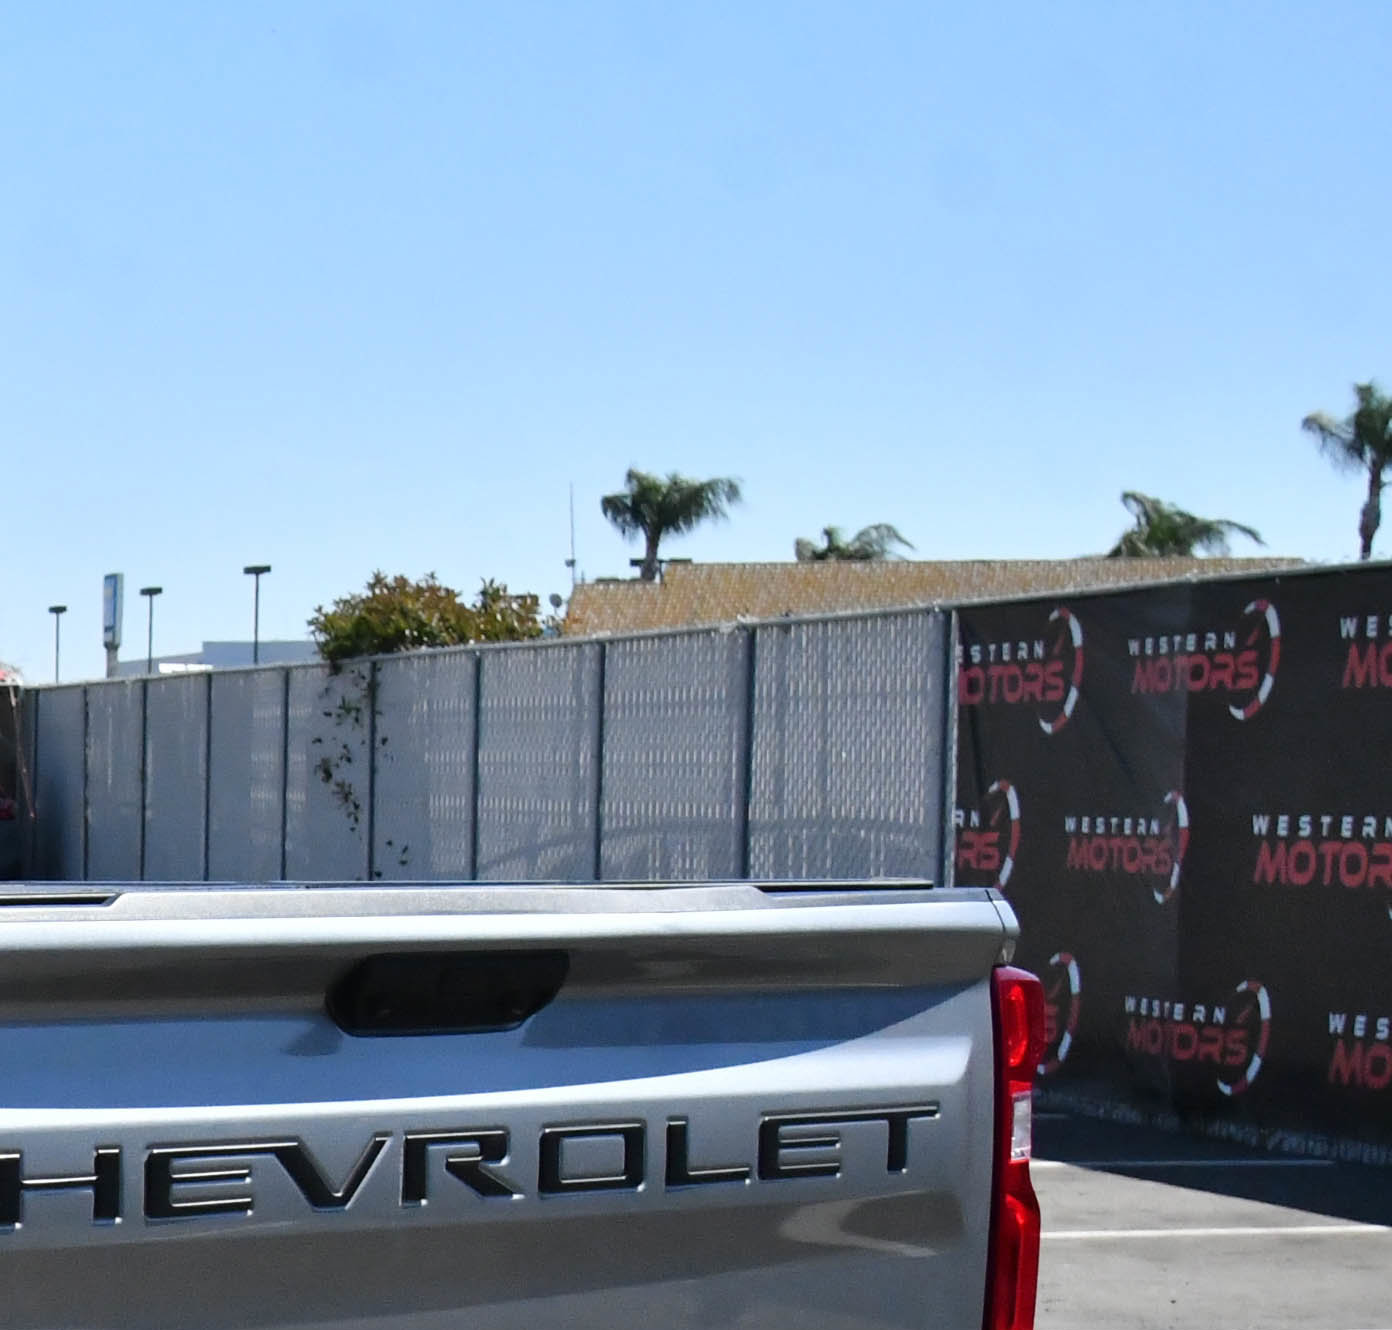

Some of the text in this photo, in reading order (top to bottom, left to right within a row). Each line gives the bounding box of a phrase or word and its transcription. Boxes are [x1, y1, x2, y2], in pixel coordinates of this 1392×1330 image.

[1128, 631, 1236, 656] WESTERN
[1131, 649, 1259, 694] MOTORS
[1065, 816, 1159, 835] WESTERN
[1067, 835, 1174, 875] MOTORS
[1124, 995, 1227, 1025] WESTERN
[1127, 1017, 1249, 1066] MOTORS
